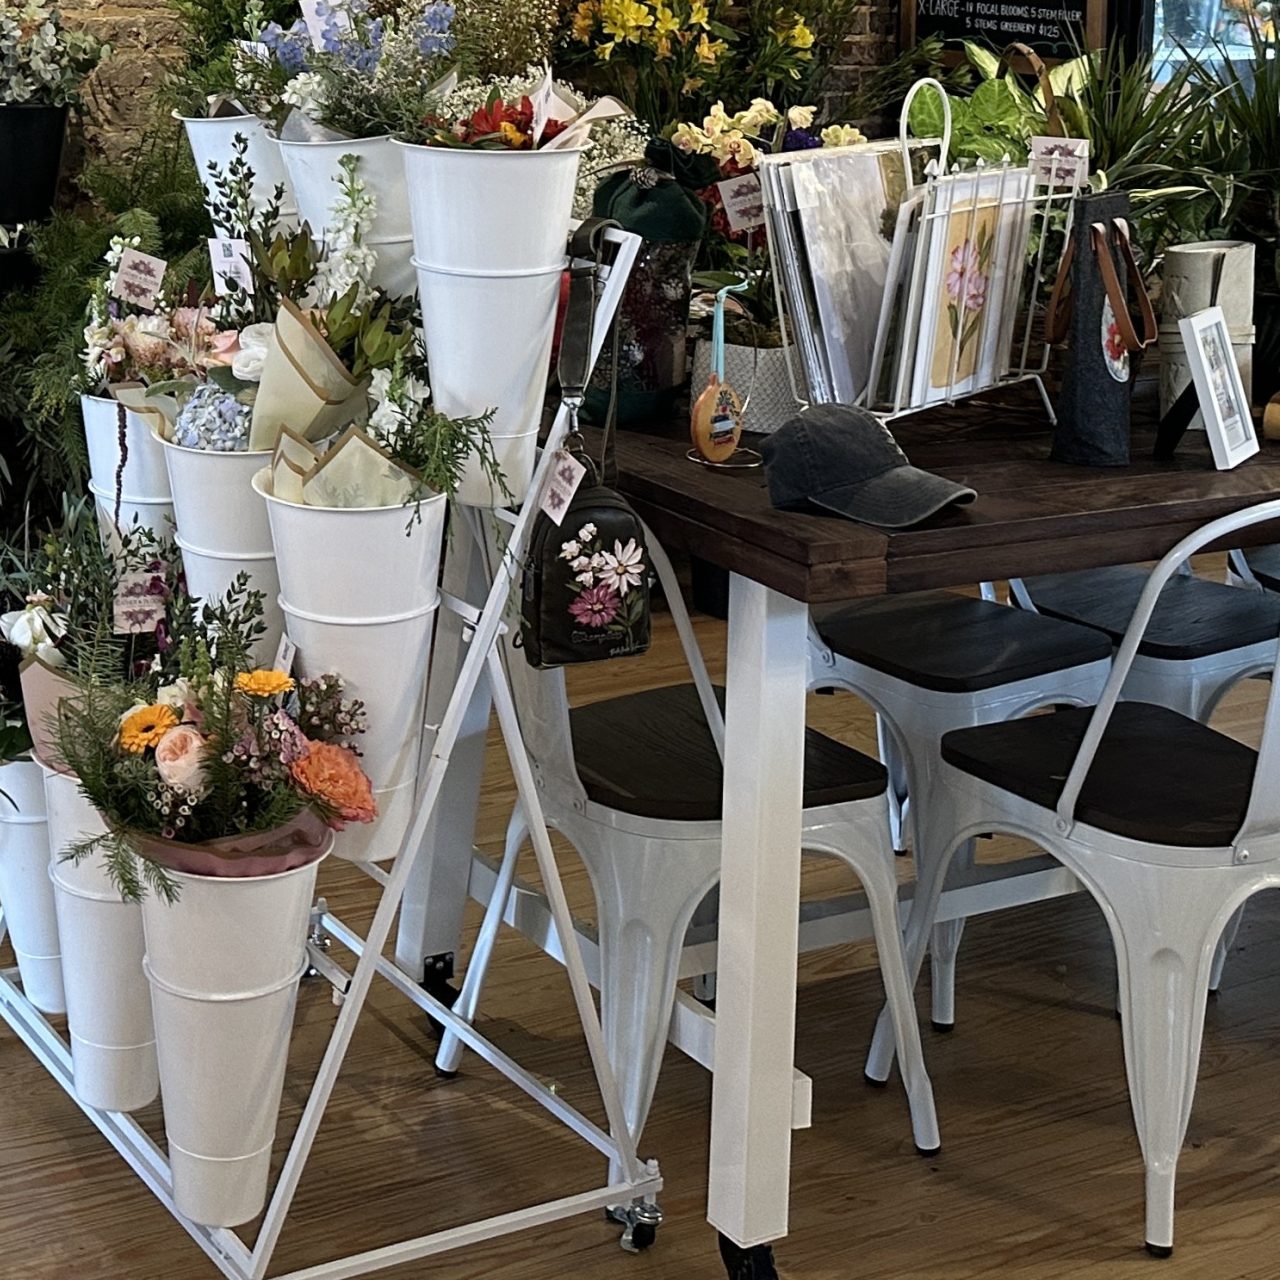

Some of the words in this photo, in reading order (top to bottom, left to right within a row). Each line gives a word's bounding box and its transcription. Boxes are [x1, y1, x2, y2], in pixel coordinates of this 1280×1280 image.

[976, 2, 999, 16] FOCAL
[1037, 8, 1057, 21] STEM
[974, 18, 998, 31] STEMS
[1000, 21, 1036, 34] GREENERY
[1038, 23, 1060, 38] $125
